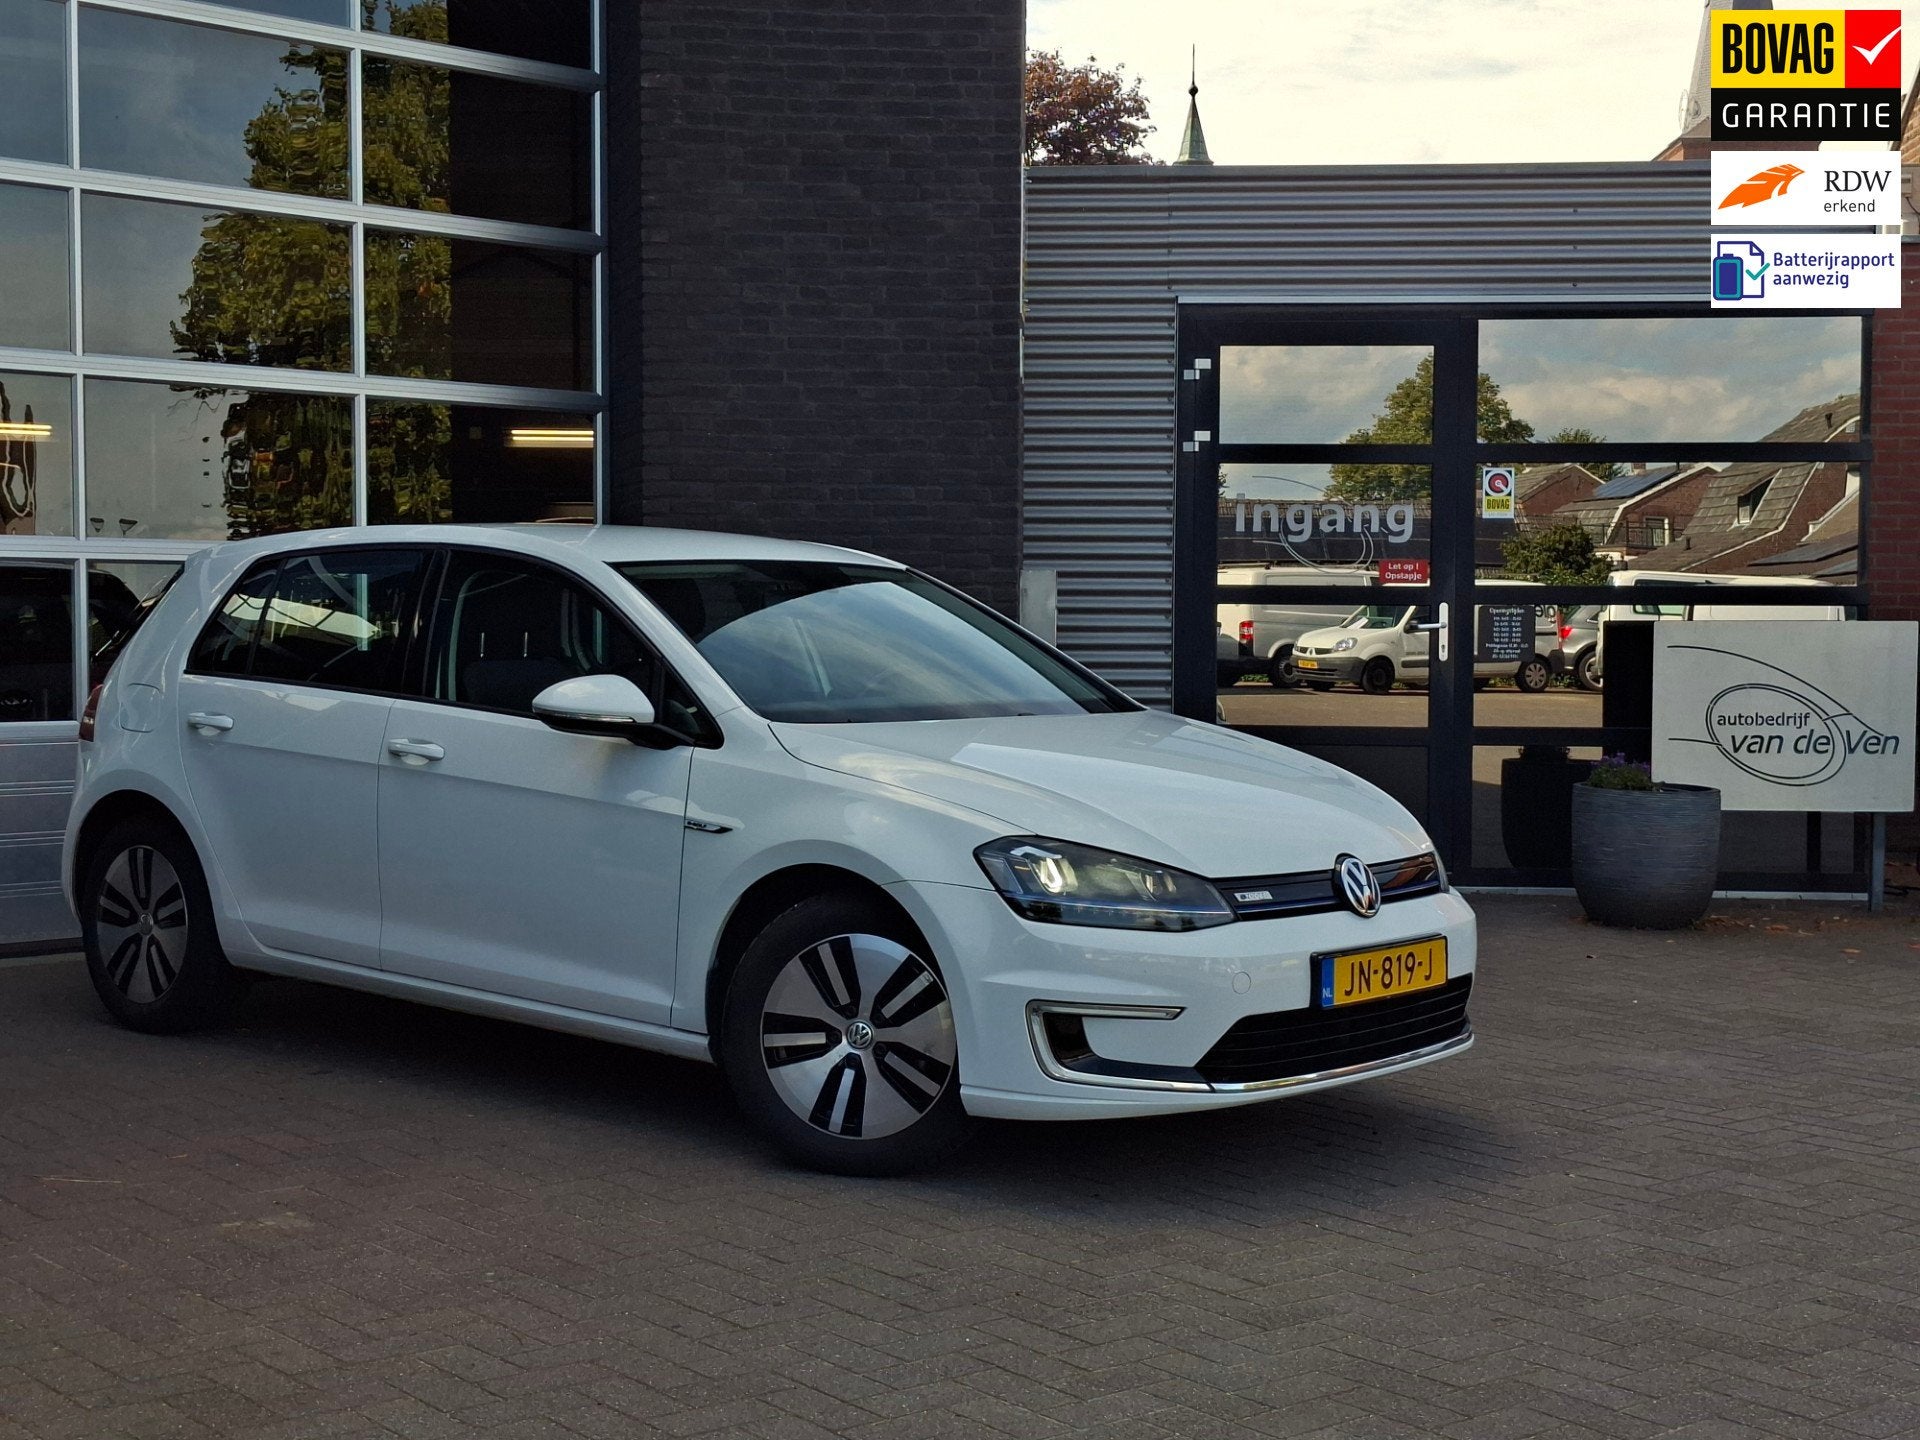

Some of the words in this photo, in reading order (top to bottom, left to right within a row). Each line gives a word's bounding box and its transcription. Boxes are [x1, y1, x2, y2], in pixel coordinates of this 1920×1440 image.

[1486, 498, 1510, 510] BOVAG
[1235, 493, 1414, 544] ingang
[1388, 562, 1401, 570] Let
[1385, 571, 1422, 581] Opstapje
[1717, 712, 1810, 729] autobedrijf
[1731, 733, 1784, 754] van
[1793, 729, 1831, 754] de
[1845, 729, 1900, 755] Ven
[1322, 987, 1333, 998] NL
[1344, 948, 1432, 997] JN-819-J
